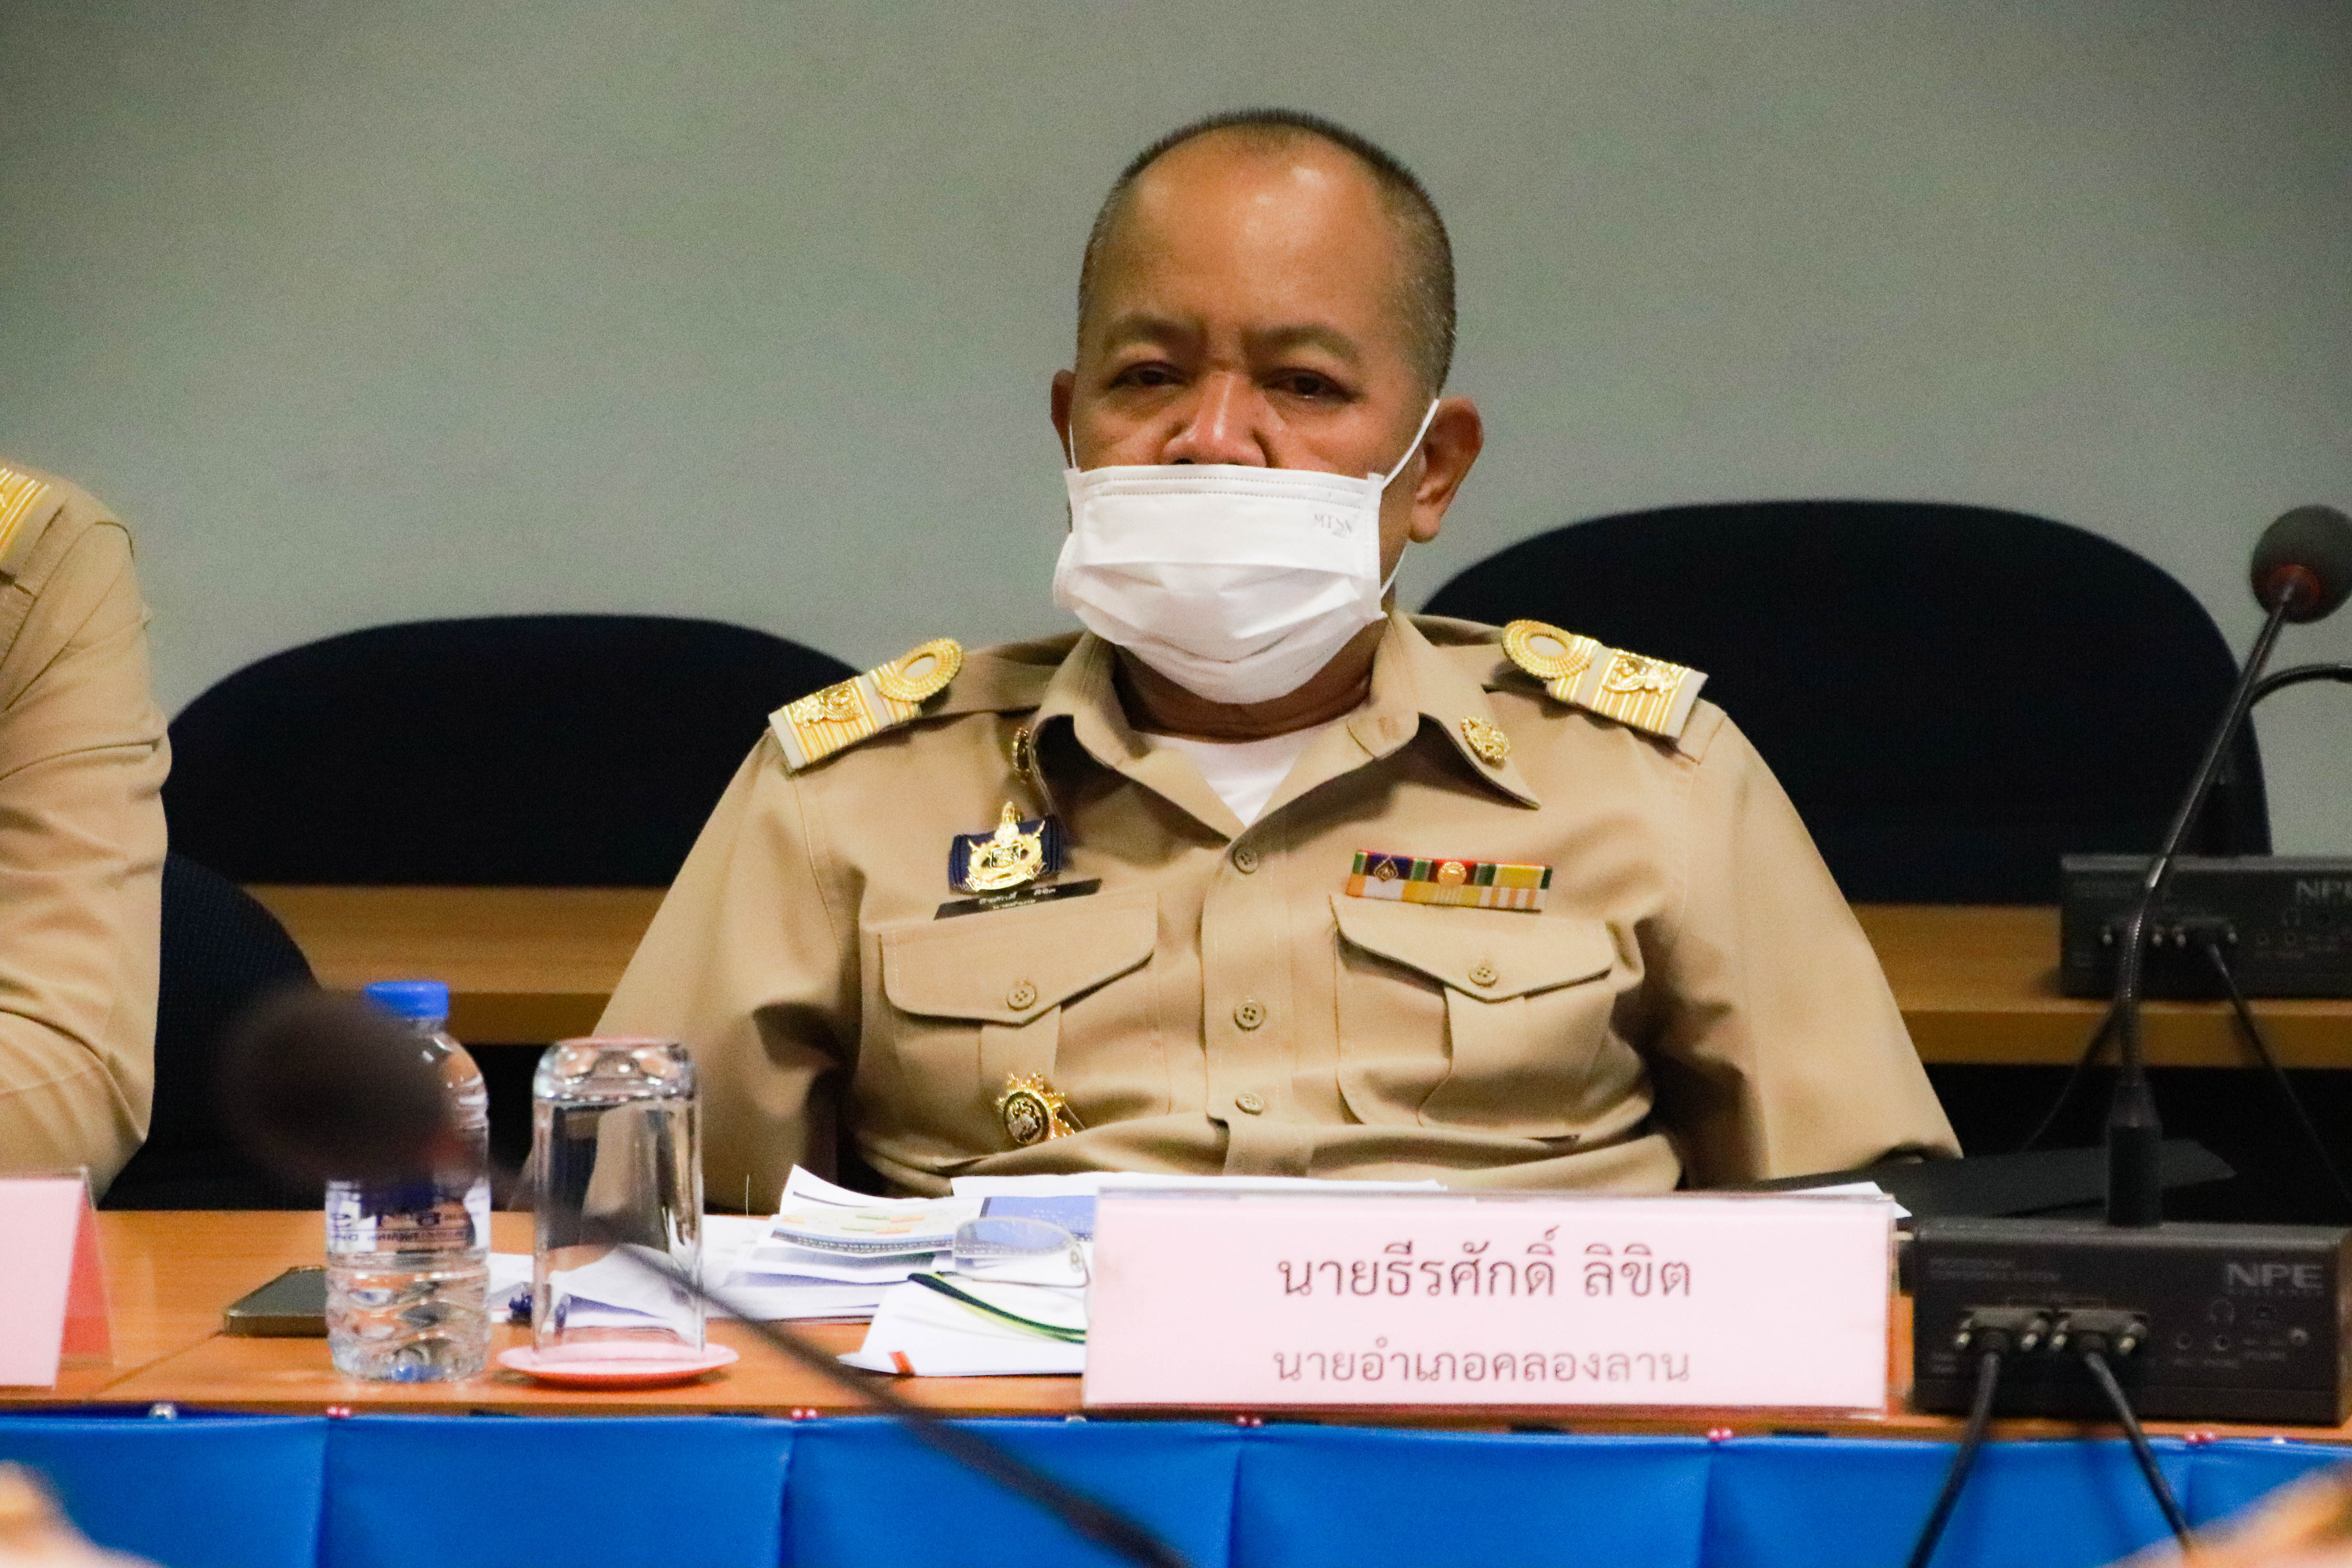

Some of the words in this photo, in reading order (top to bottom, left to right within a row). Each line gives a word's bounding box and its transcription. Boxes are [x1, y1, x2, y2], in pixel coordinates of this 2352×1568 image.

[1278, 1225, 1560, 1297] นายธีรศักดิ์
[1583, 1242, 1691, 1297] ลิขิต
[2227, 1263, 2323, 1289] NPE
[1273, 1336, 1690, 1382] นายอำเภอคลองลาน
